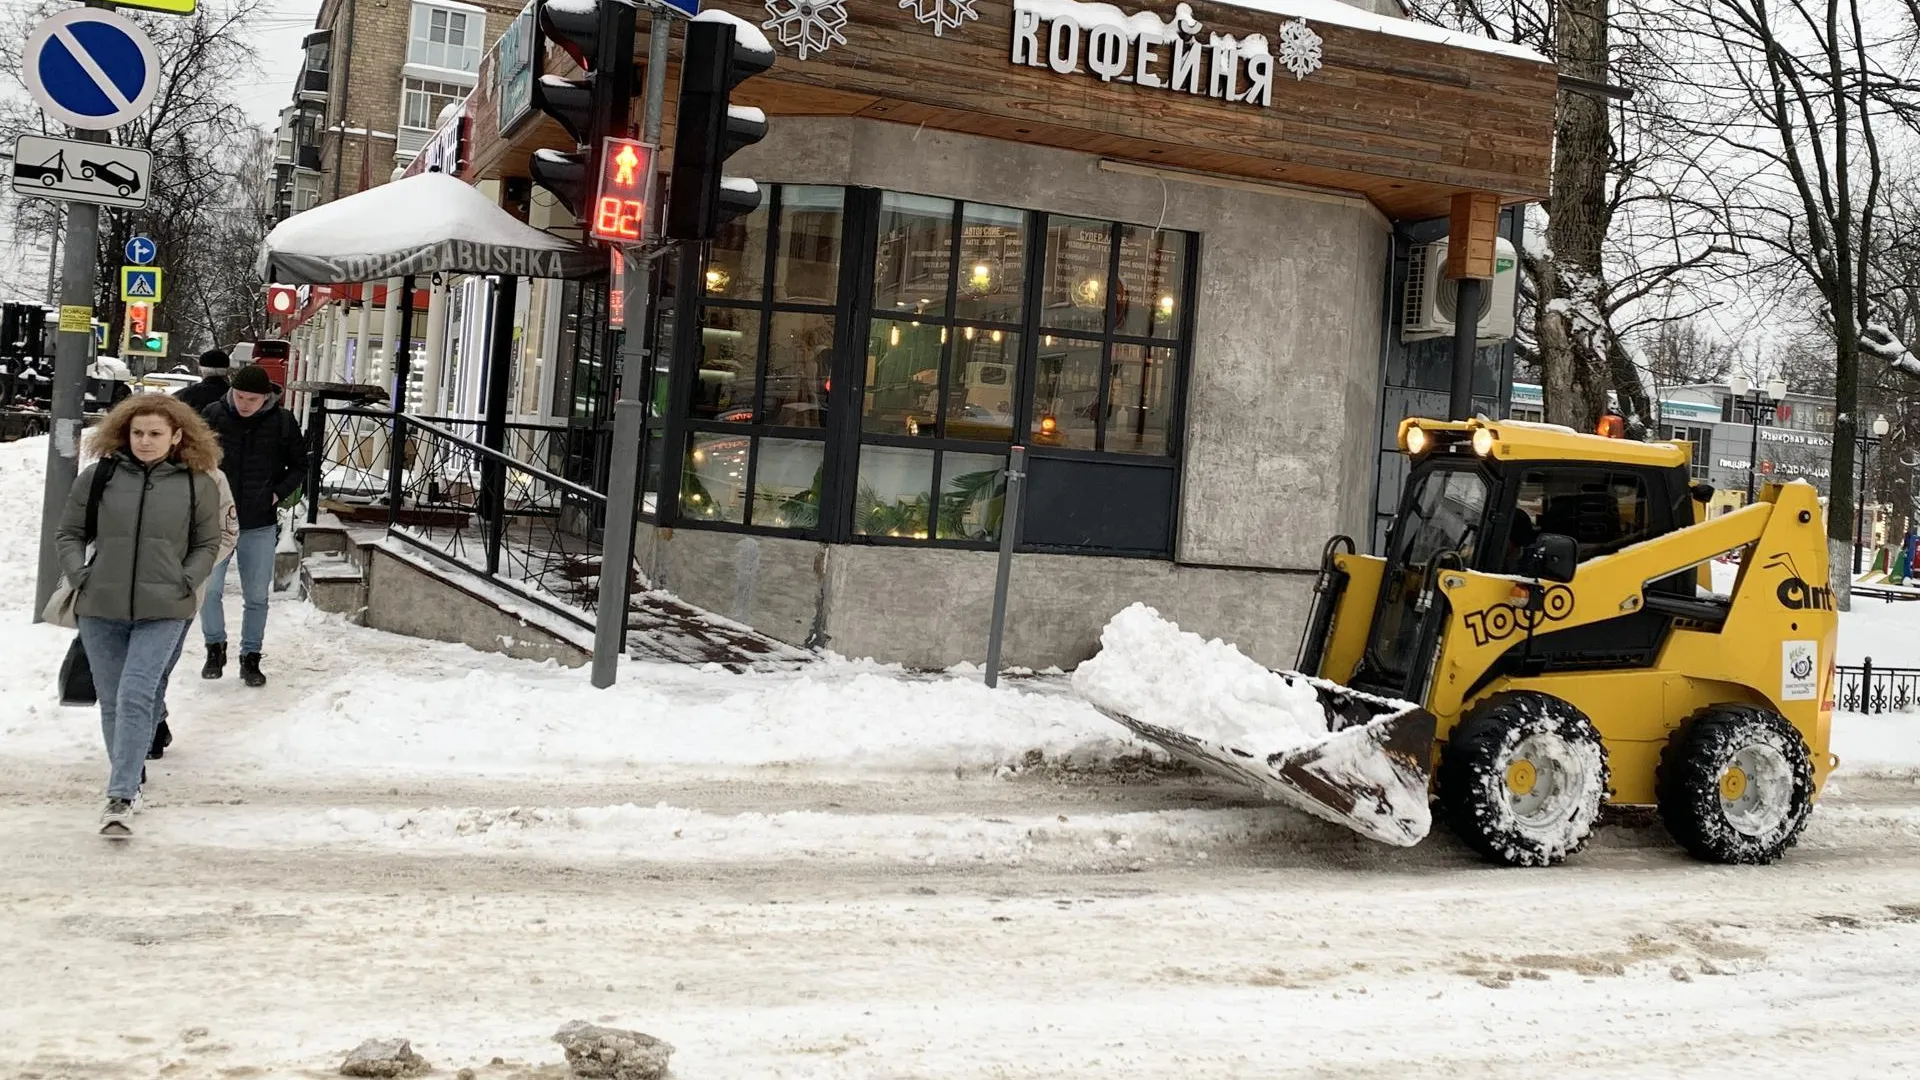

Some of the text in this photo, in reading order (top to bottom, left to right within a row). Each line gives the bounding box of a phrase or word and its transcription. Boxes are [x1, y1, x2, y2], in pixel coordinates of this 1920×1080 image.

[1011, 9, 1274, 107] КОФЕЙНЯ
[598, 197, 642, 236] 82
[421, 239, 564, 279] BABUSHKA
[1719, 459, 1751, 470] ПИЦЦЕРИ
